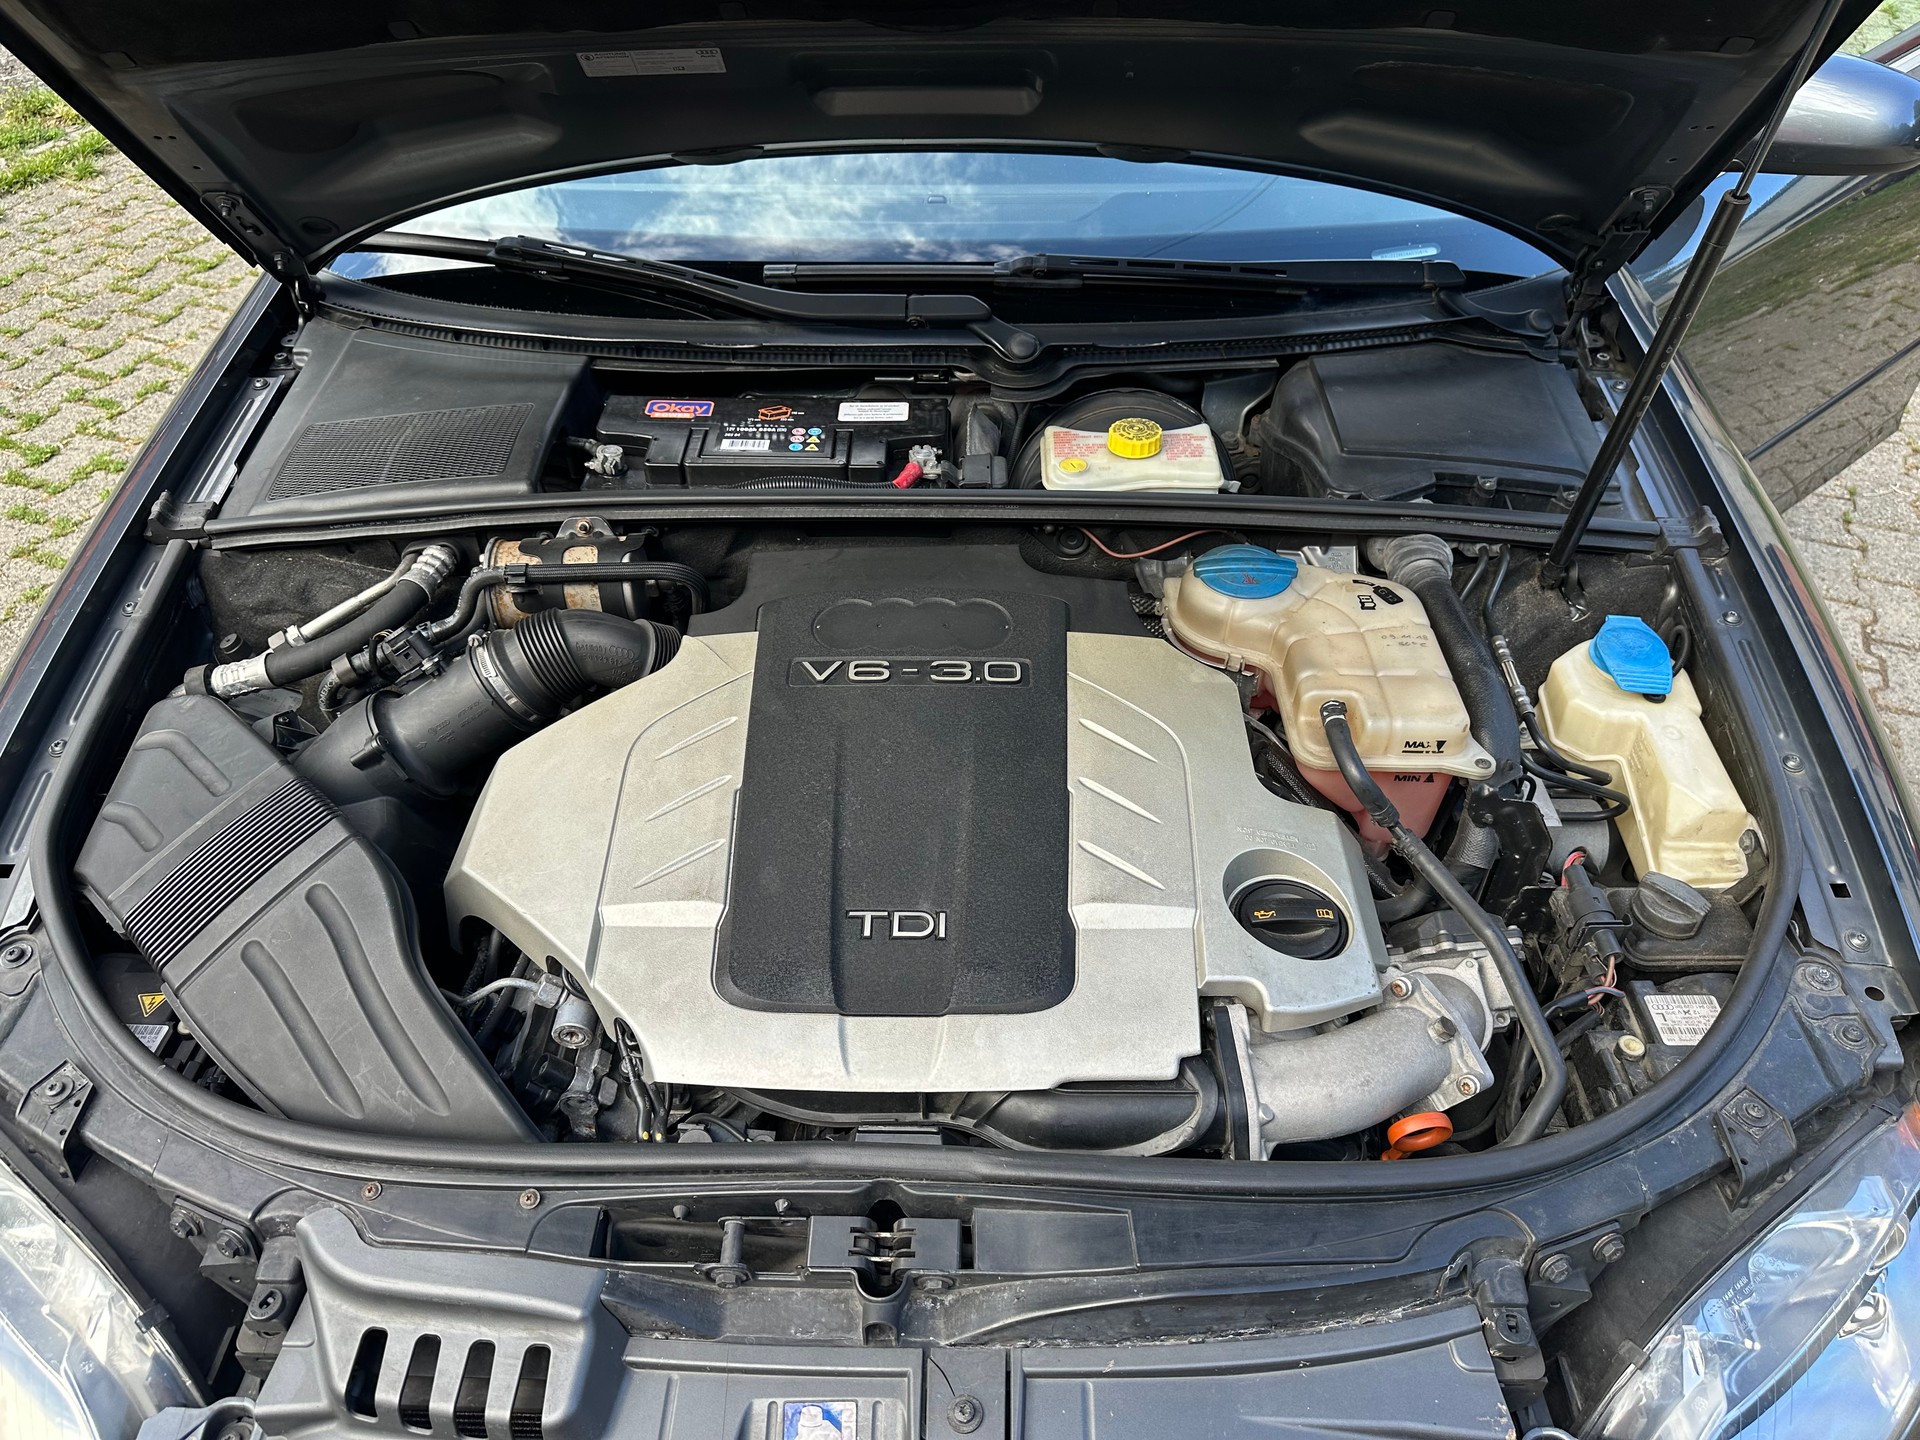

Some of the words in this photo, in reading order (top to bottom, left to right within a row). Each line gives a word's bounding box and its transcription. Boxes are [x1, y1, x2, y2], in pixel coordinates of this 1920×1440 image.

[653, 402, 708, 414] Okay
[1393, 774, 1421, 782] MIN
[846, 911, 947, 939] TDI
